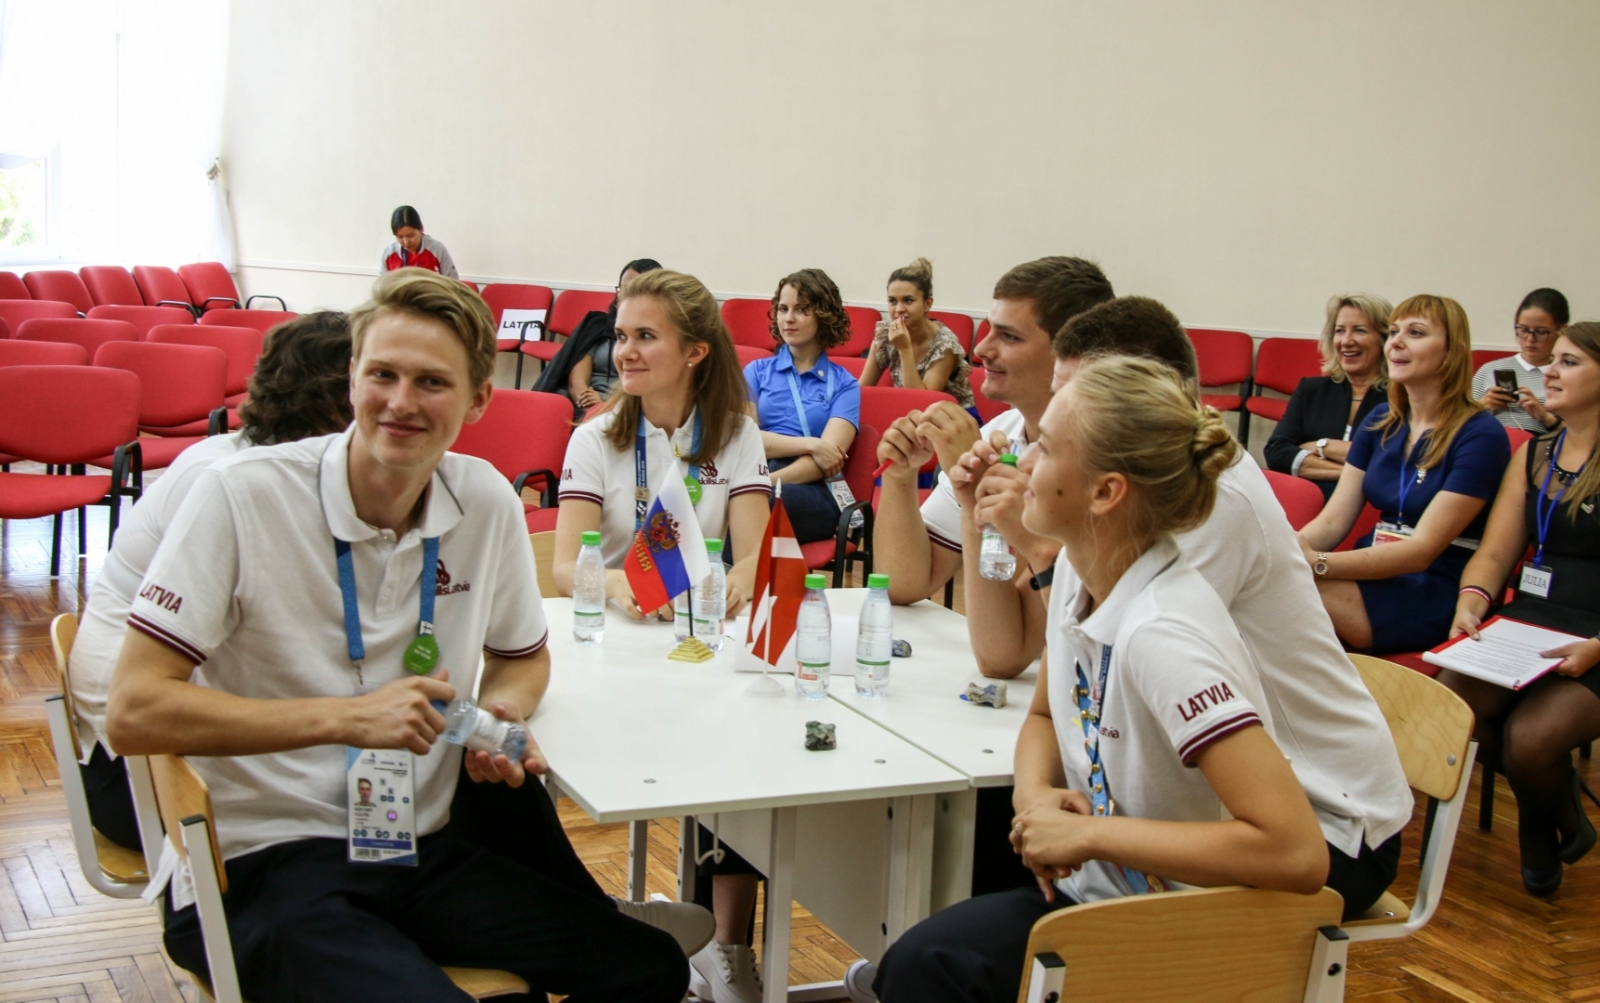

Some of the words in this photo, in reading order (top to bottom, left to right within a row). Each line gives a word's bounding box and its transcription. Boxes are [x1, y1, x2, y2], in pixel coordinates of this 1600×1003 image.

[502, 320, 541, 329] LATIA
[1522, 573, 1547, 589] JULIA
[139, 581, 183, 614] LATVIA
[1177, 681, 1235, 722] LATVIA
